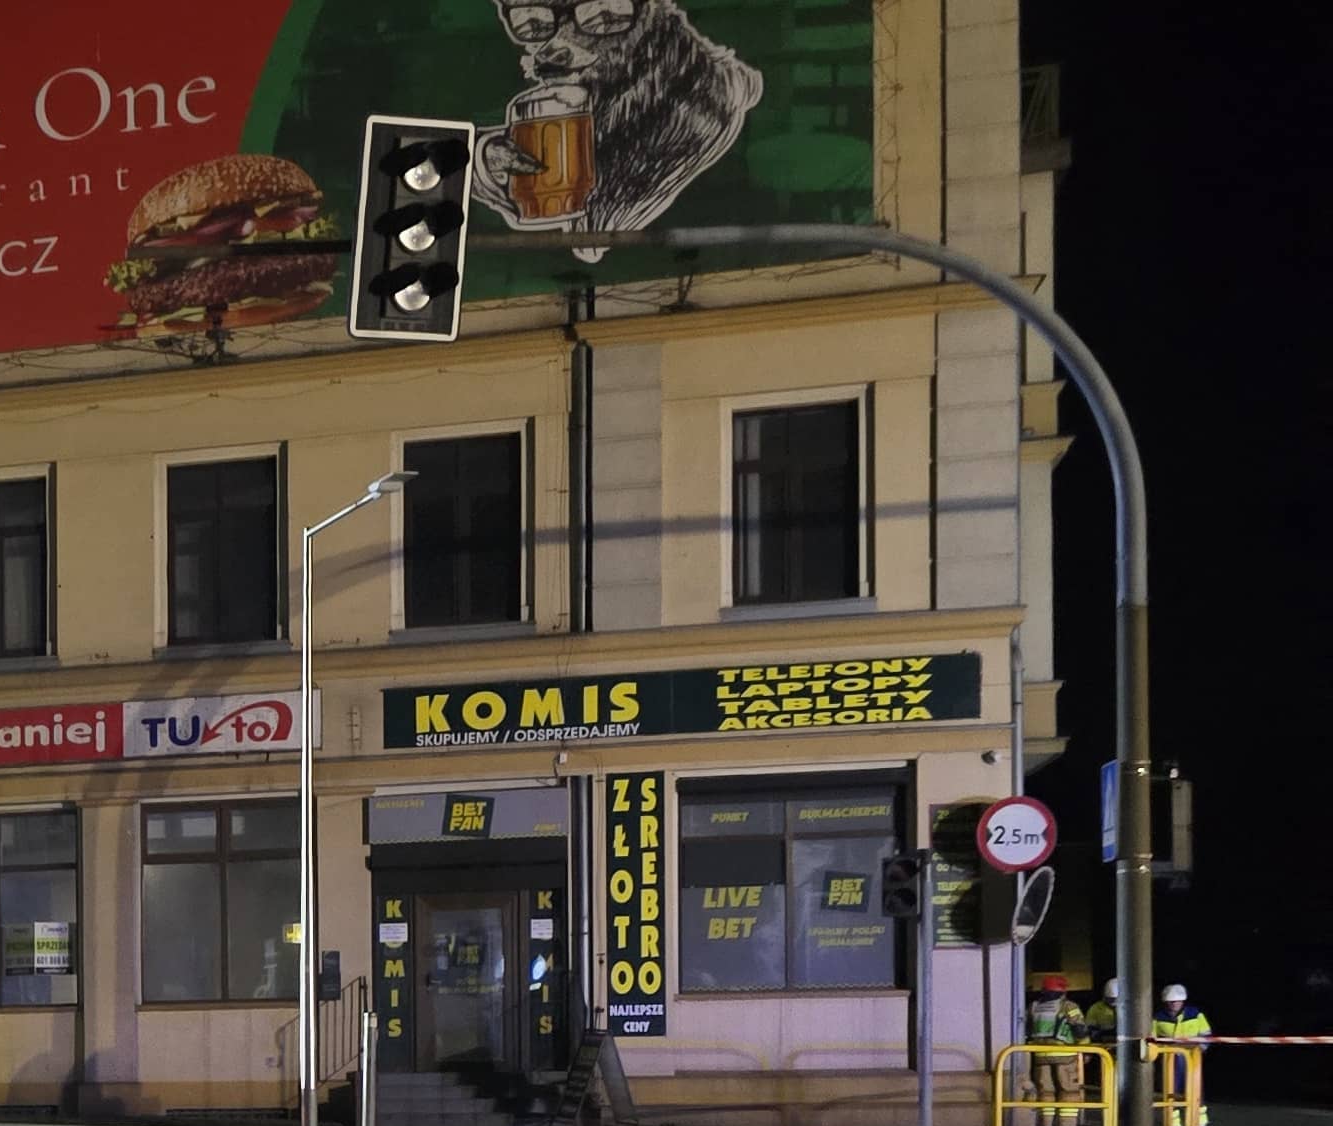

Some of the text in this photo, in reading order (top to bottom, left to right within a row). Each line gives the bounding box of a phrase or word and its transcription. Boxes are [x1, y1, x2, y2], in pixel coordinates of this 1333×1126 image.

[33, 66, 217, 142] One
[717, 656, 933, 682] TELEFONY
[716, 673, 933, 699] LAPTOPY
[414, 681, 640, 734] KOMIS
[717, 689, 933, 715] TABLETY
[717, 706, 933, 731] AKCESORIA
[141, 715, 201, 748] TU
[415, 730, 501, 748] SKUPUJEMY
[514, 722, 640, 742] ODSPRZEDAJEMY
[451, 801, 487, 818] BET
[710, 811, 749, 824] PUNKT
[799, 804, 893, 821] BUKMACHERSKI
[449, 816, 486, 832] FAN
[637, 777, 662, 995] SREBRO
[703, 885, 764, 909] LIVE
[830, 878, 865, 893] BET
[828, 891, 864, 906] FAN
[707, 916, 757, 940] BET
[384, 899, 406, 1038] KMIS
[609, 1003, 664, 1017] NAJLEPSZE
[623, 1020, 650, 1033] CENY
